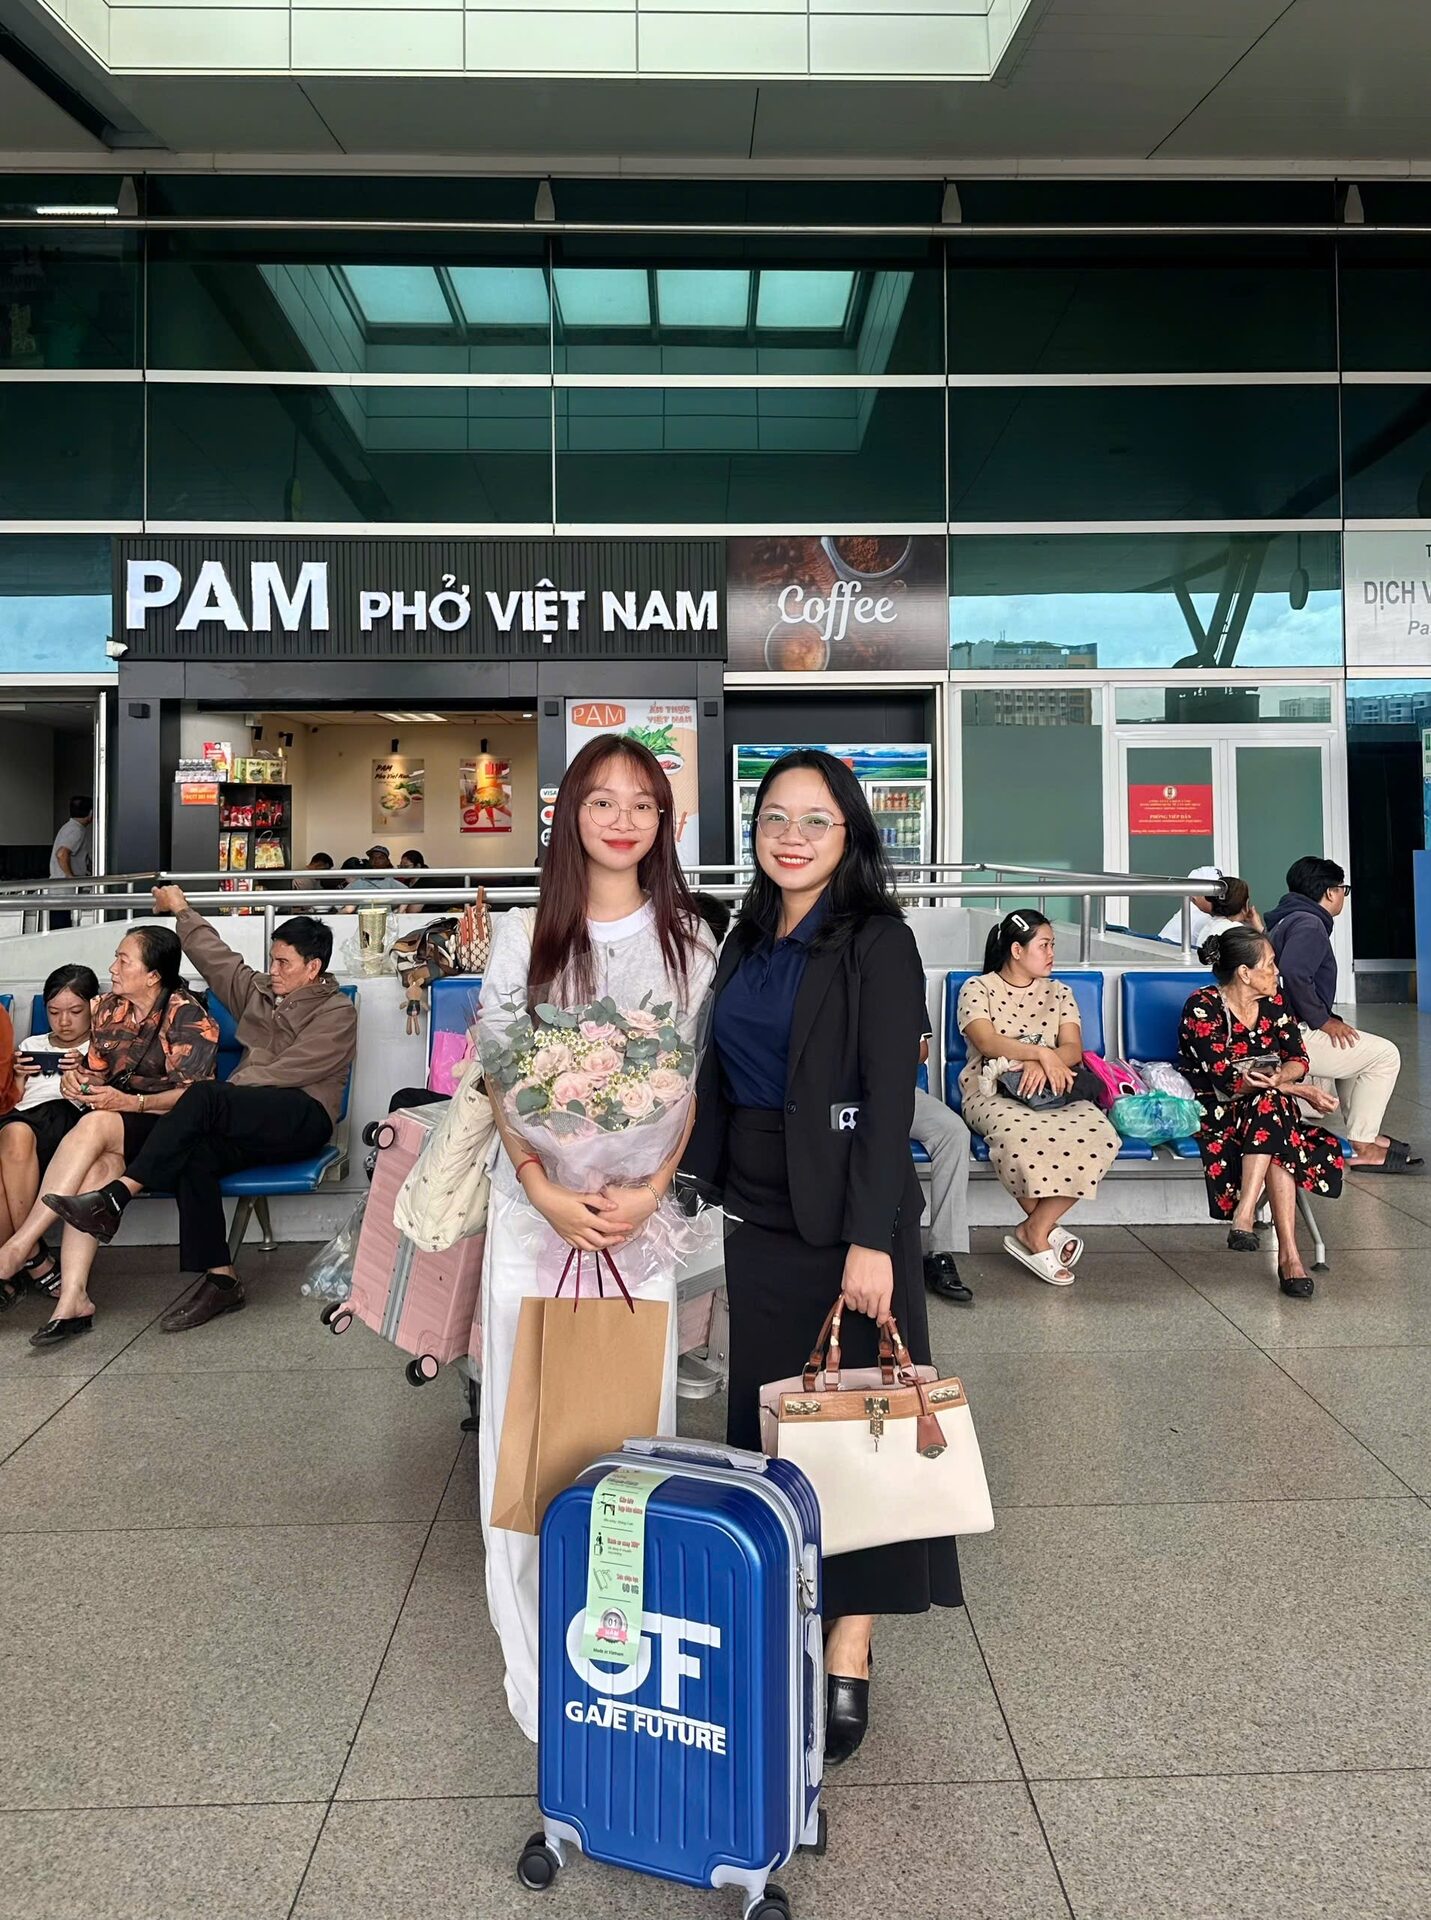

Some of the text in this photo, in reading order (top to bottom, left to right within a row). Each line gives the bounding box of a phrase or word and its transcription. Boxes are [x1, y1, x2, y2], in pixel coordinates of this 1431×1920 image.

[126, 559, 718, 643] PAM PHỞ VIỆT NAM
[777, 580, 898, 641] Coffee
[1363, 580, 1416, 611] DỊCH
[1407, 620, 1431, 636] Pa
[573, 704, 624, 726] PAM
[607, 1617, 618, 1627] 01
[564, 1697, 727, 1756] GATE FUTURE
